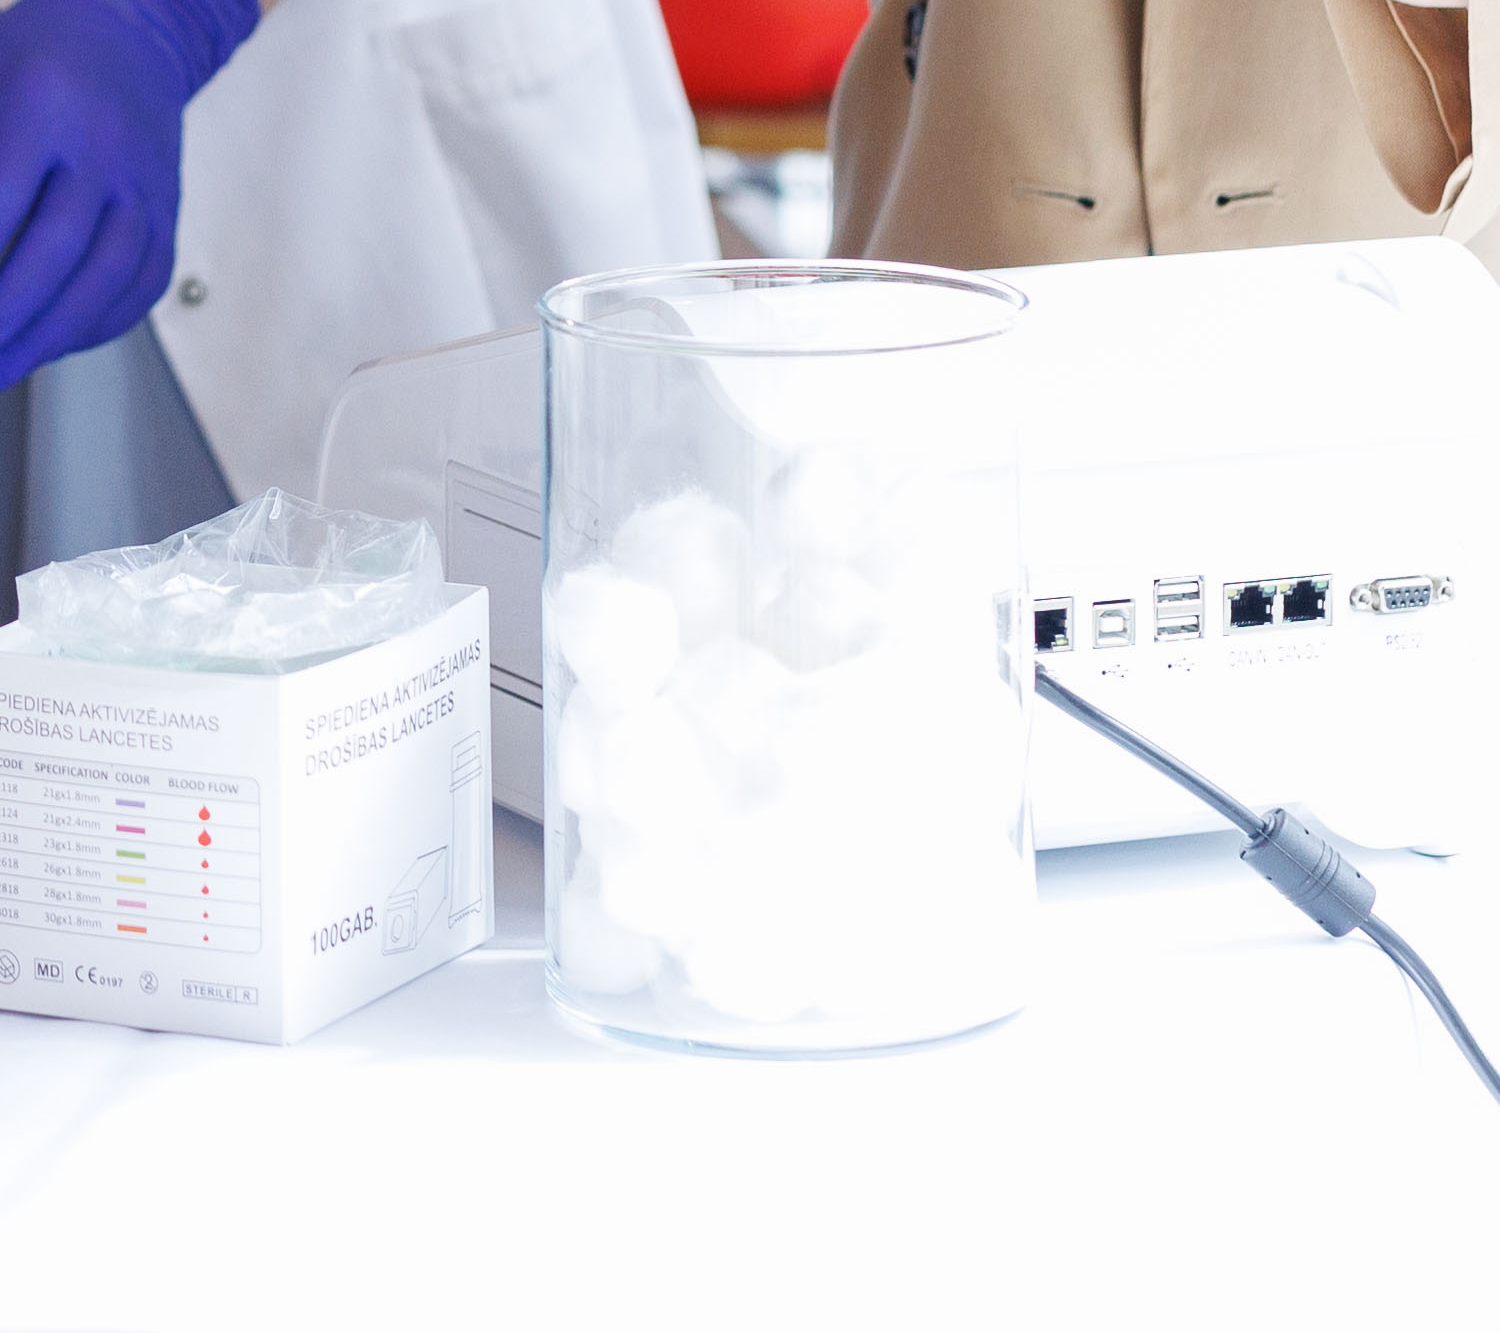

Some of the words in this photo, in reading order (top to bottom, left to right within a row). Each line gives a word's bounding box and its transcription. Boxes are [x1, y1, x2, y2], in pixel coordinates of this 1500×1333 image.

[306, 691, 389, 740] SPIEDIENA
[393, 638, 481, 706] AKTIVIZĒJAMAS
[79, 703, 220, 733] AKTIVIZĒJAMAS
[306, 726, 387, 776] DROŠĪBAS
[392, 690, 454, 743] LANCETES
[78, 726, 174, 752] LANCETES
[34, 761, 108, 781] SPECIFICATION
[115, 771, 150, 786] COLOR
[168, 777, 205, 791] BLOOD
[208, 780, 239, 794] FLOW
[310, 905, 378, 956] 100GAB.
[36, 962, 61, 979] MD
[99, 975, 123, 988] 0197
[185, 983, 233, 1000] STERILE
